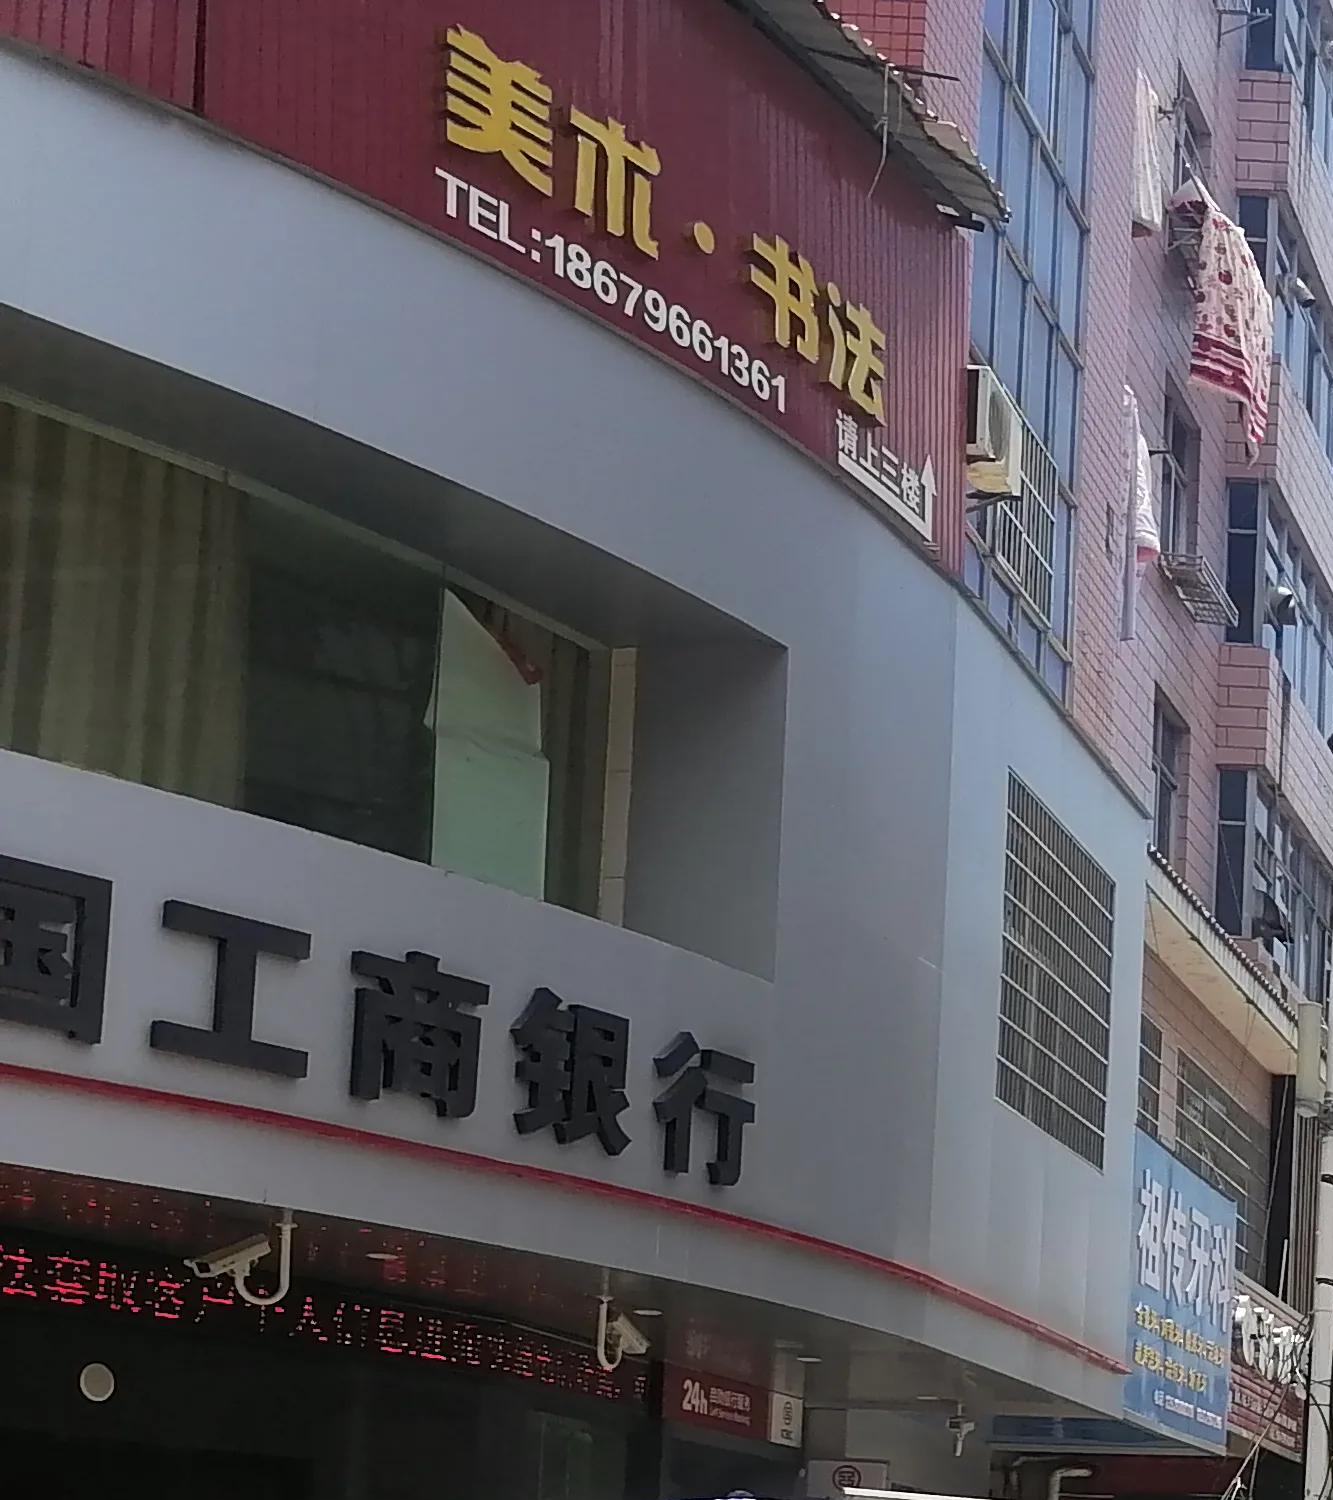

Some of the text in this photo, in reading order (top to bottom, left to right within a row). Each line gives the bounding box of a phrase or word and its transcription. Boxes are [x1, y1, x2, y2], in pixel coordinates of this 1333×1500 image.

[435, 167, 787, 414] TEL:18679661361
[834, 409, 921, 514] 请上三楼
[1137, 1168, 1231, 1333] 祖传牙科
[683, 1378, 708, 1416] 24h
